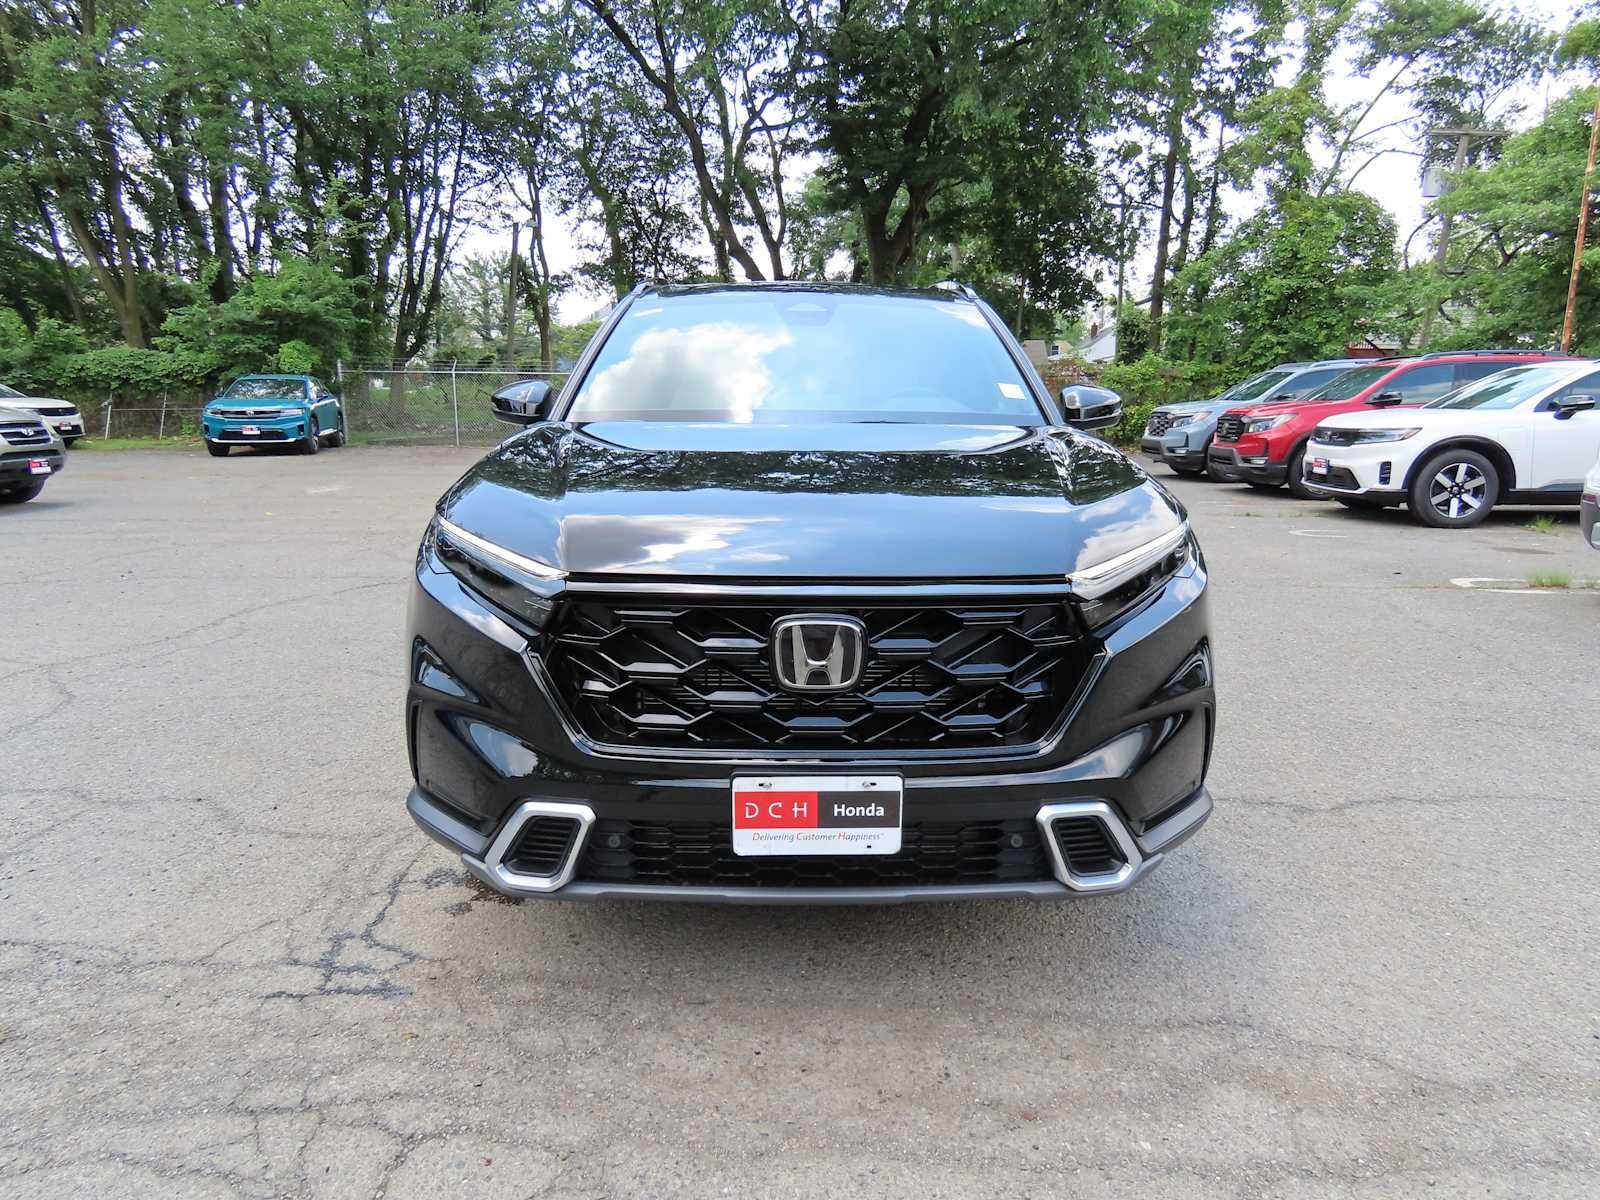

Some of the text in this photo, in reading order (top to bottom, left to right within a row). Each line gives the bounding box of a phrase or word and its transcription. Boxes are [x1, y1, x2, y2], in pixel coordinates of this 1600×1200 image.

[833, 803, 885, 817] Honda
[752, 832, 881, 842] Delivering Customer Happiness
